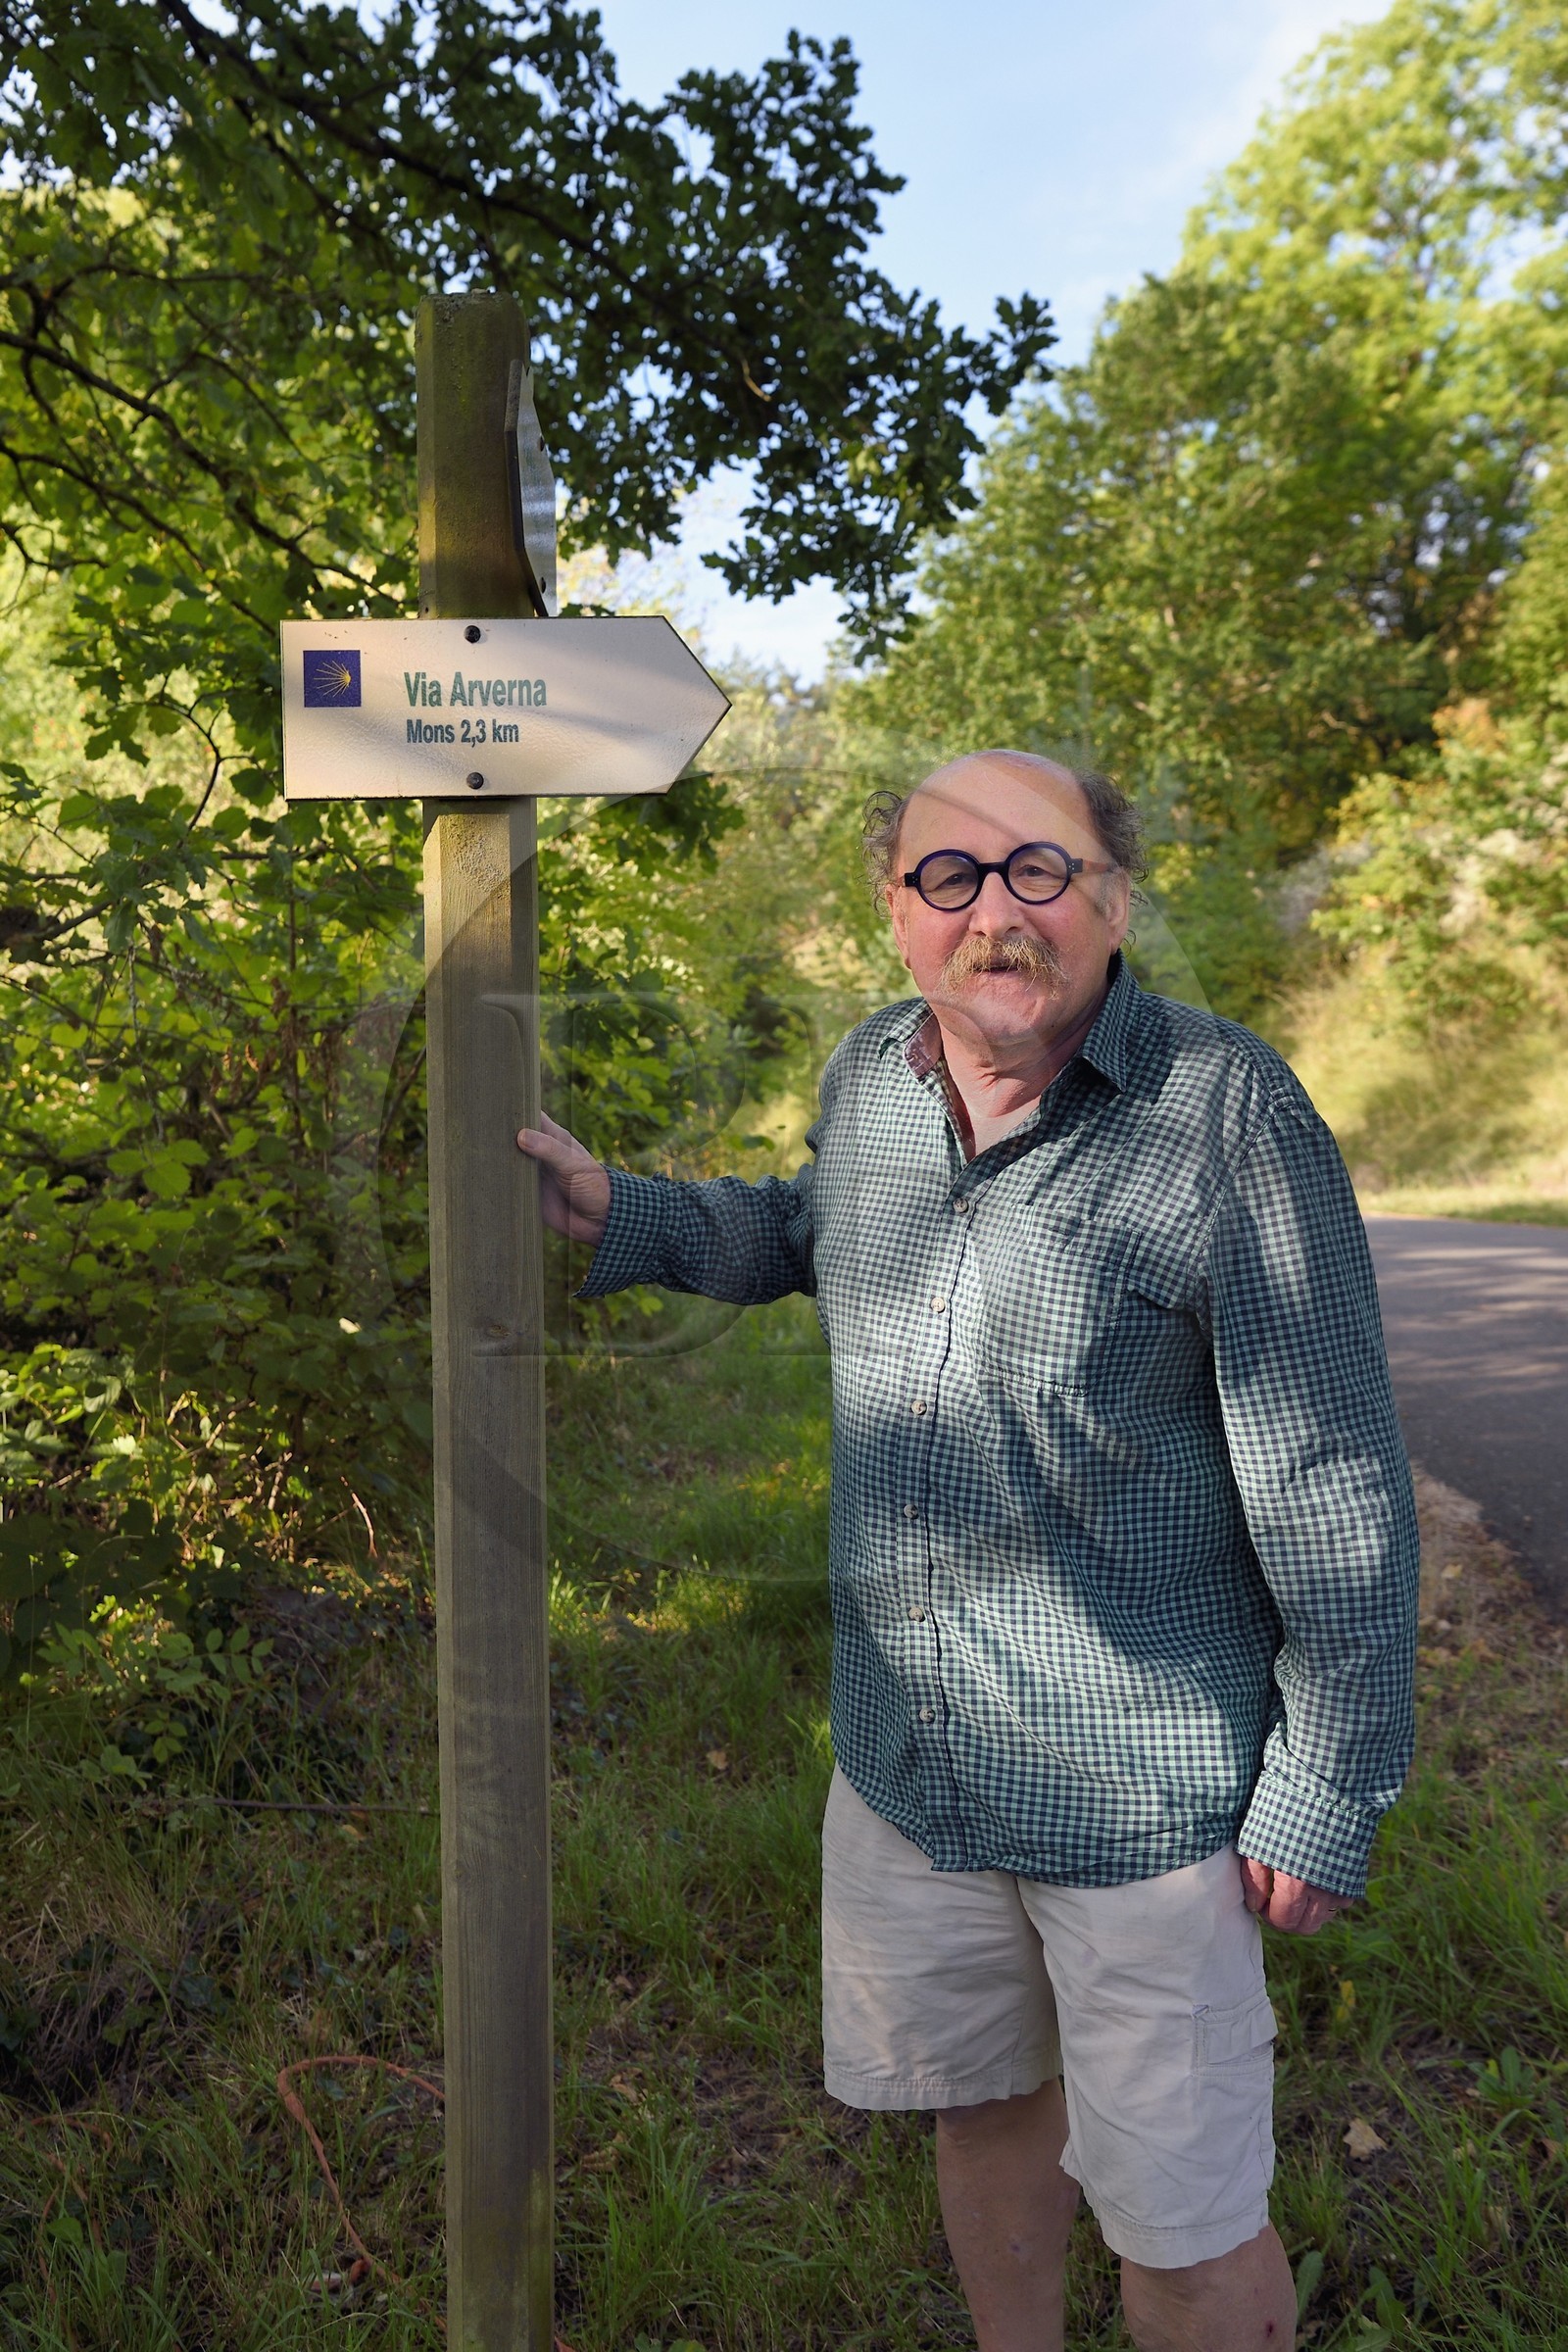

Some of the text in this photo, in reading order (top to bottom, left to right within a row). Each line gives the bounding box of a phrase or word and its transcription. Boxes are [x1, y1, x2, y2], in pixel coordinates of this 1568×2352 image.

[404, 671, 547, 707] Via Arverna
[407, 718, 519, 748] Mons 2,3 km
